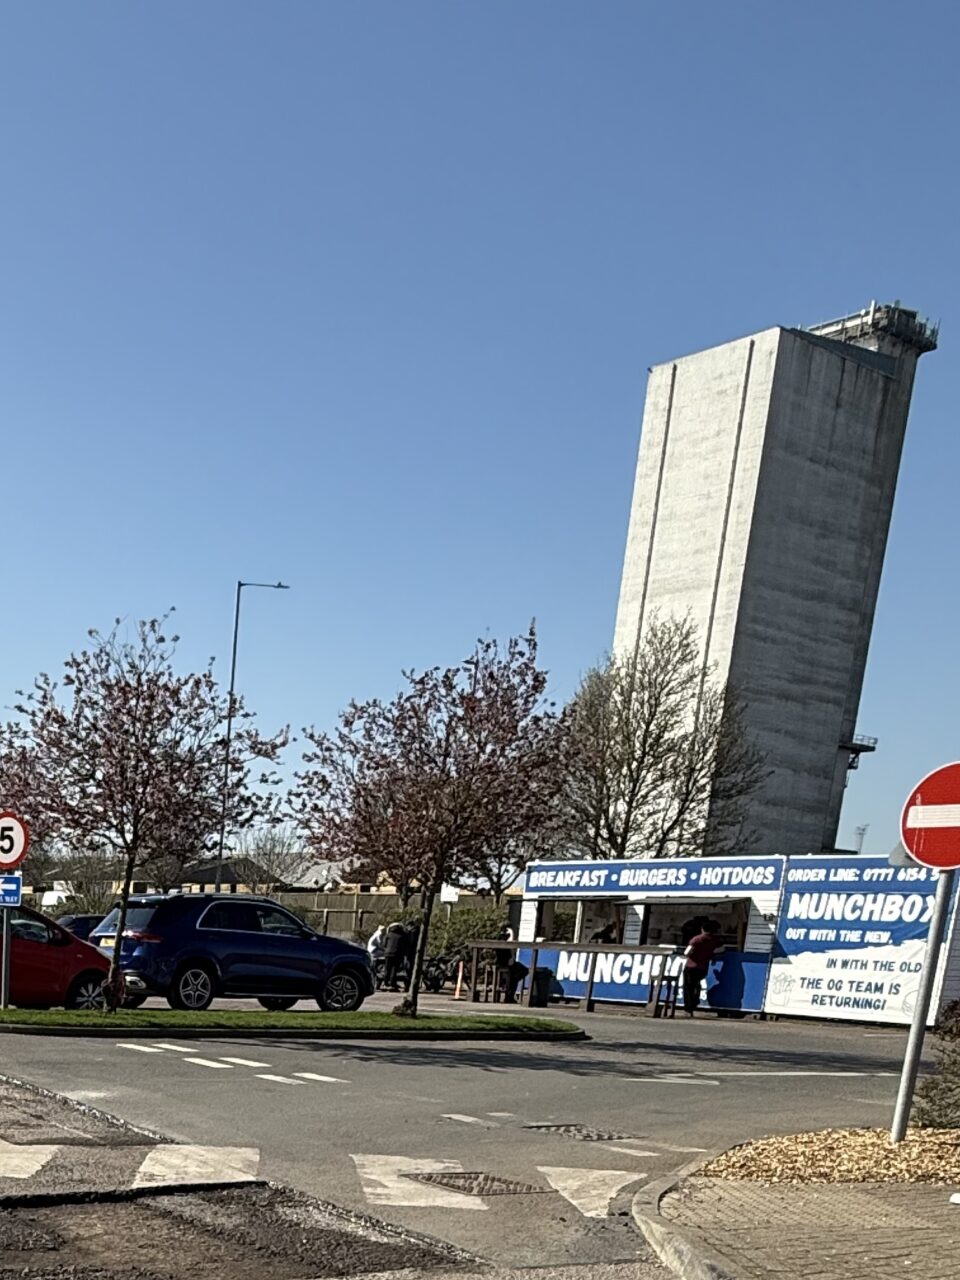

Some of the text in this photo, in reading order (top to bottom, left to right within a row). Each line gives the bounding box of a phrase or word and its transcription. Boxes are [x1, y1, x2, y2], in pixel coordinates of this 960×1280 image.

[0, 827, 14, 854] 5
[529, 866, 775, 887] BREAKFAST BURGERS HOTDOGS
[788, 869, 825, 882] ORDER
[829, 868, 860, 881] LINE:
[5, 895, 18, 903] WAY
[786, 928, 807, 941] OUT
[809, 929, 836, 941] WITH
[839, 930, 862, 942] THE
[826, 957, 922, 973] IN WITH THE OLD
[800, 977, 902, 996] THE OG TEAM IS
[811, 994, 887, 1011] RETURNING!
